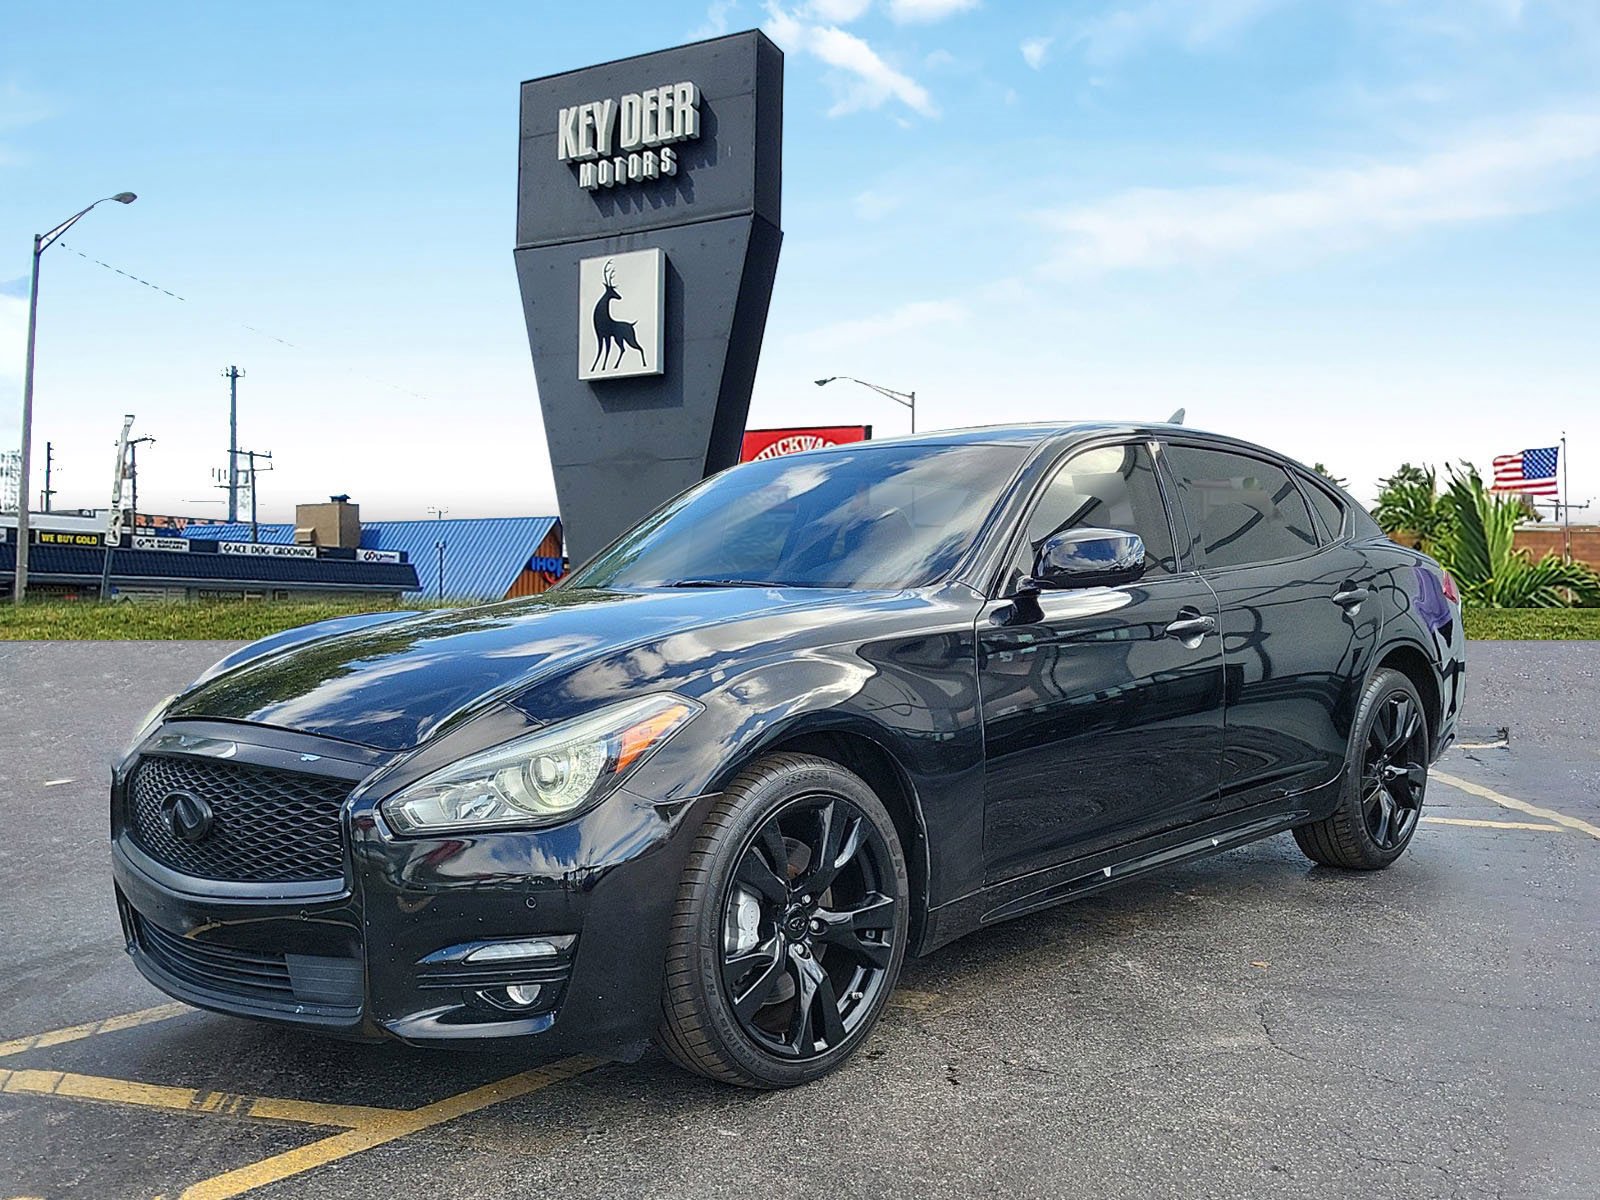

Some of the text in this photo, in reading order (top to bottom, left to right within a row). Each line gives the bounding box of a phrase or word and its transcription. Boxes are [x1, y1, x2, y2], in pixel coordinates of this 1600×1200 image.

[558, 81, 700, 163] KEY DEER
[579, 147, 677, 191] MOTORS
[41, 533, 97, 544] WE BUY GOLD
[233, 545, 315, 557] ACE DOG GROOMING
